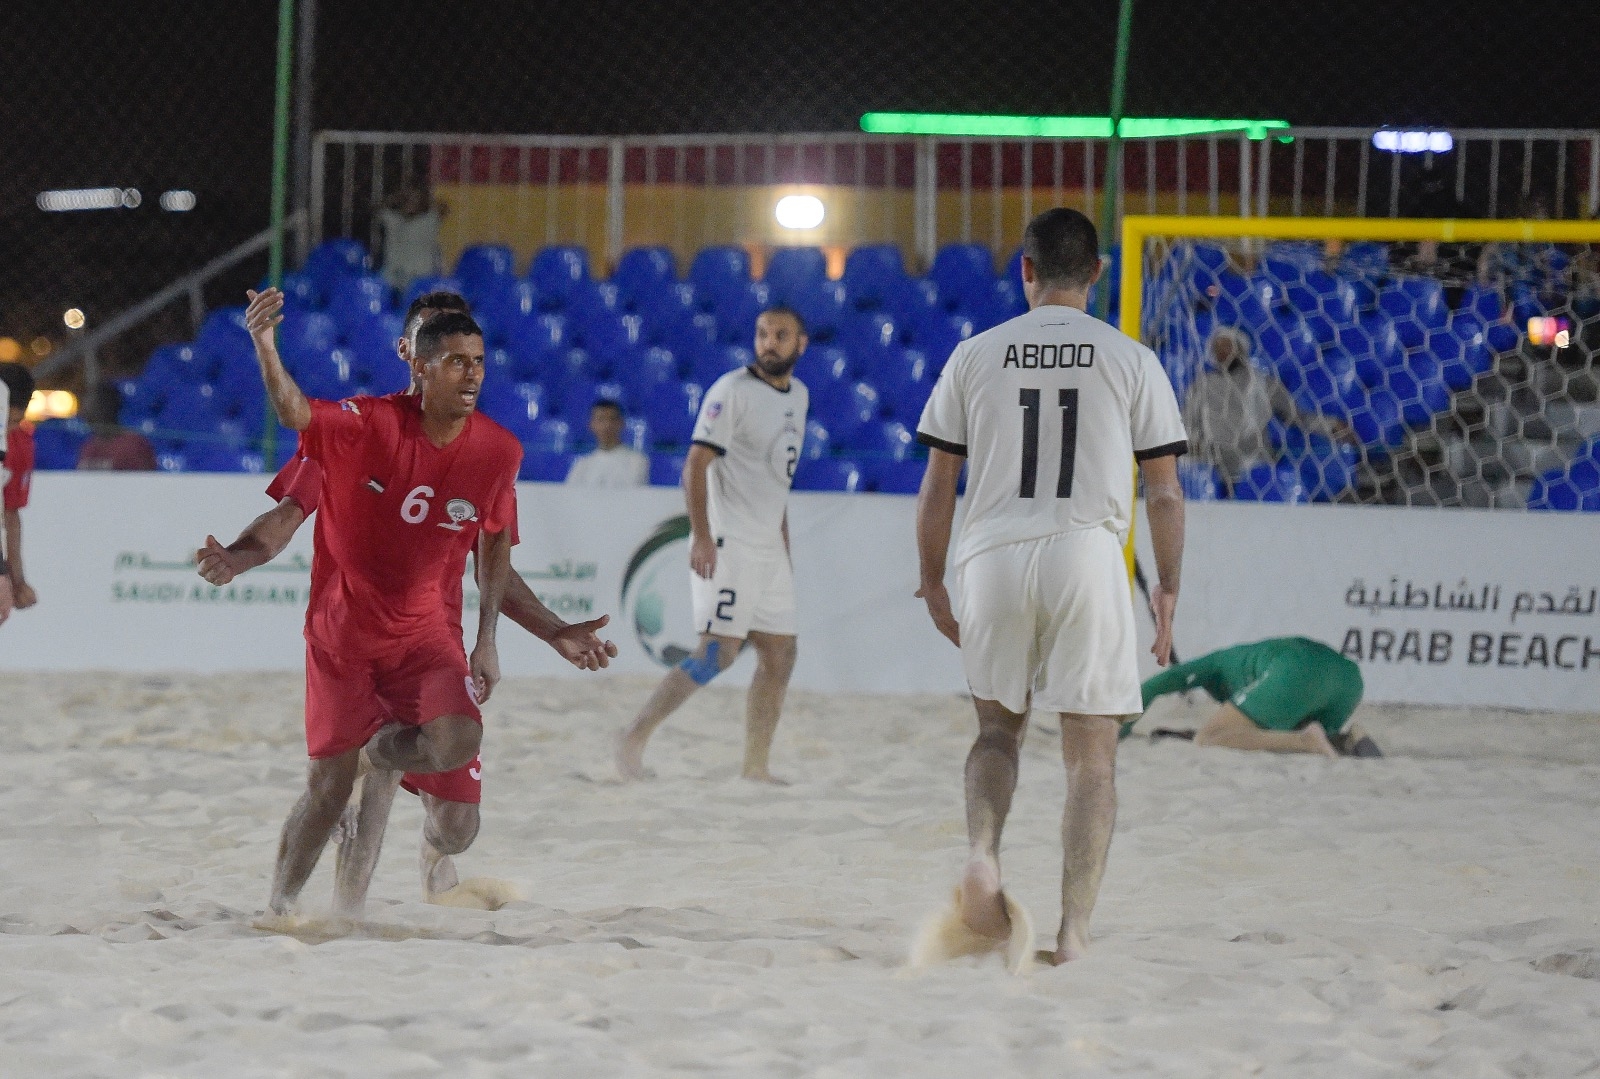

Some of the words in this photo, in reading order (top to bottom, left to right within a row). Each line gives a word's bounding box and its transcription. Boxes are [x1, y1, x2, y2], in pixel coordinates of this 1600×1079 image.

[1003, 343, 1094, 369] ABDOO
[1019, 387, 1079, 499] 11
[400, 485, 435, 524] 6
[111, 580, 183, 603] SAUDI
[187, 584, 298, 606] ARABIAN
[715, 588, 736, 621] 2
[1509, 584, 1600, 624] لقدم
[1340, 628, 1453, 664] ARAB
[1466, 631, 1600, 670] BEACH
